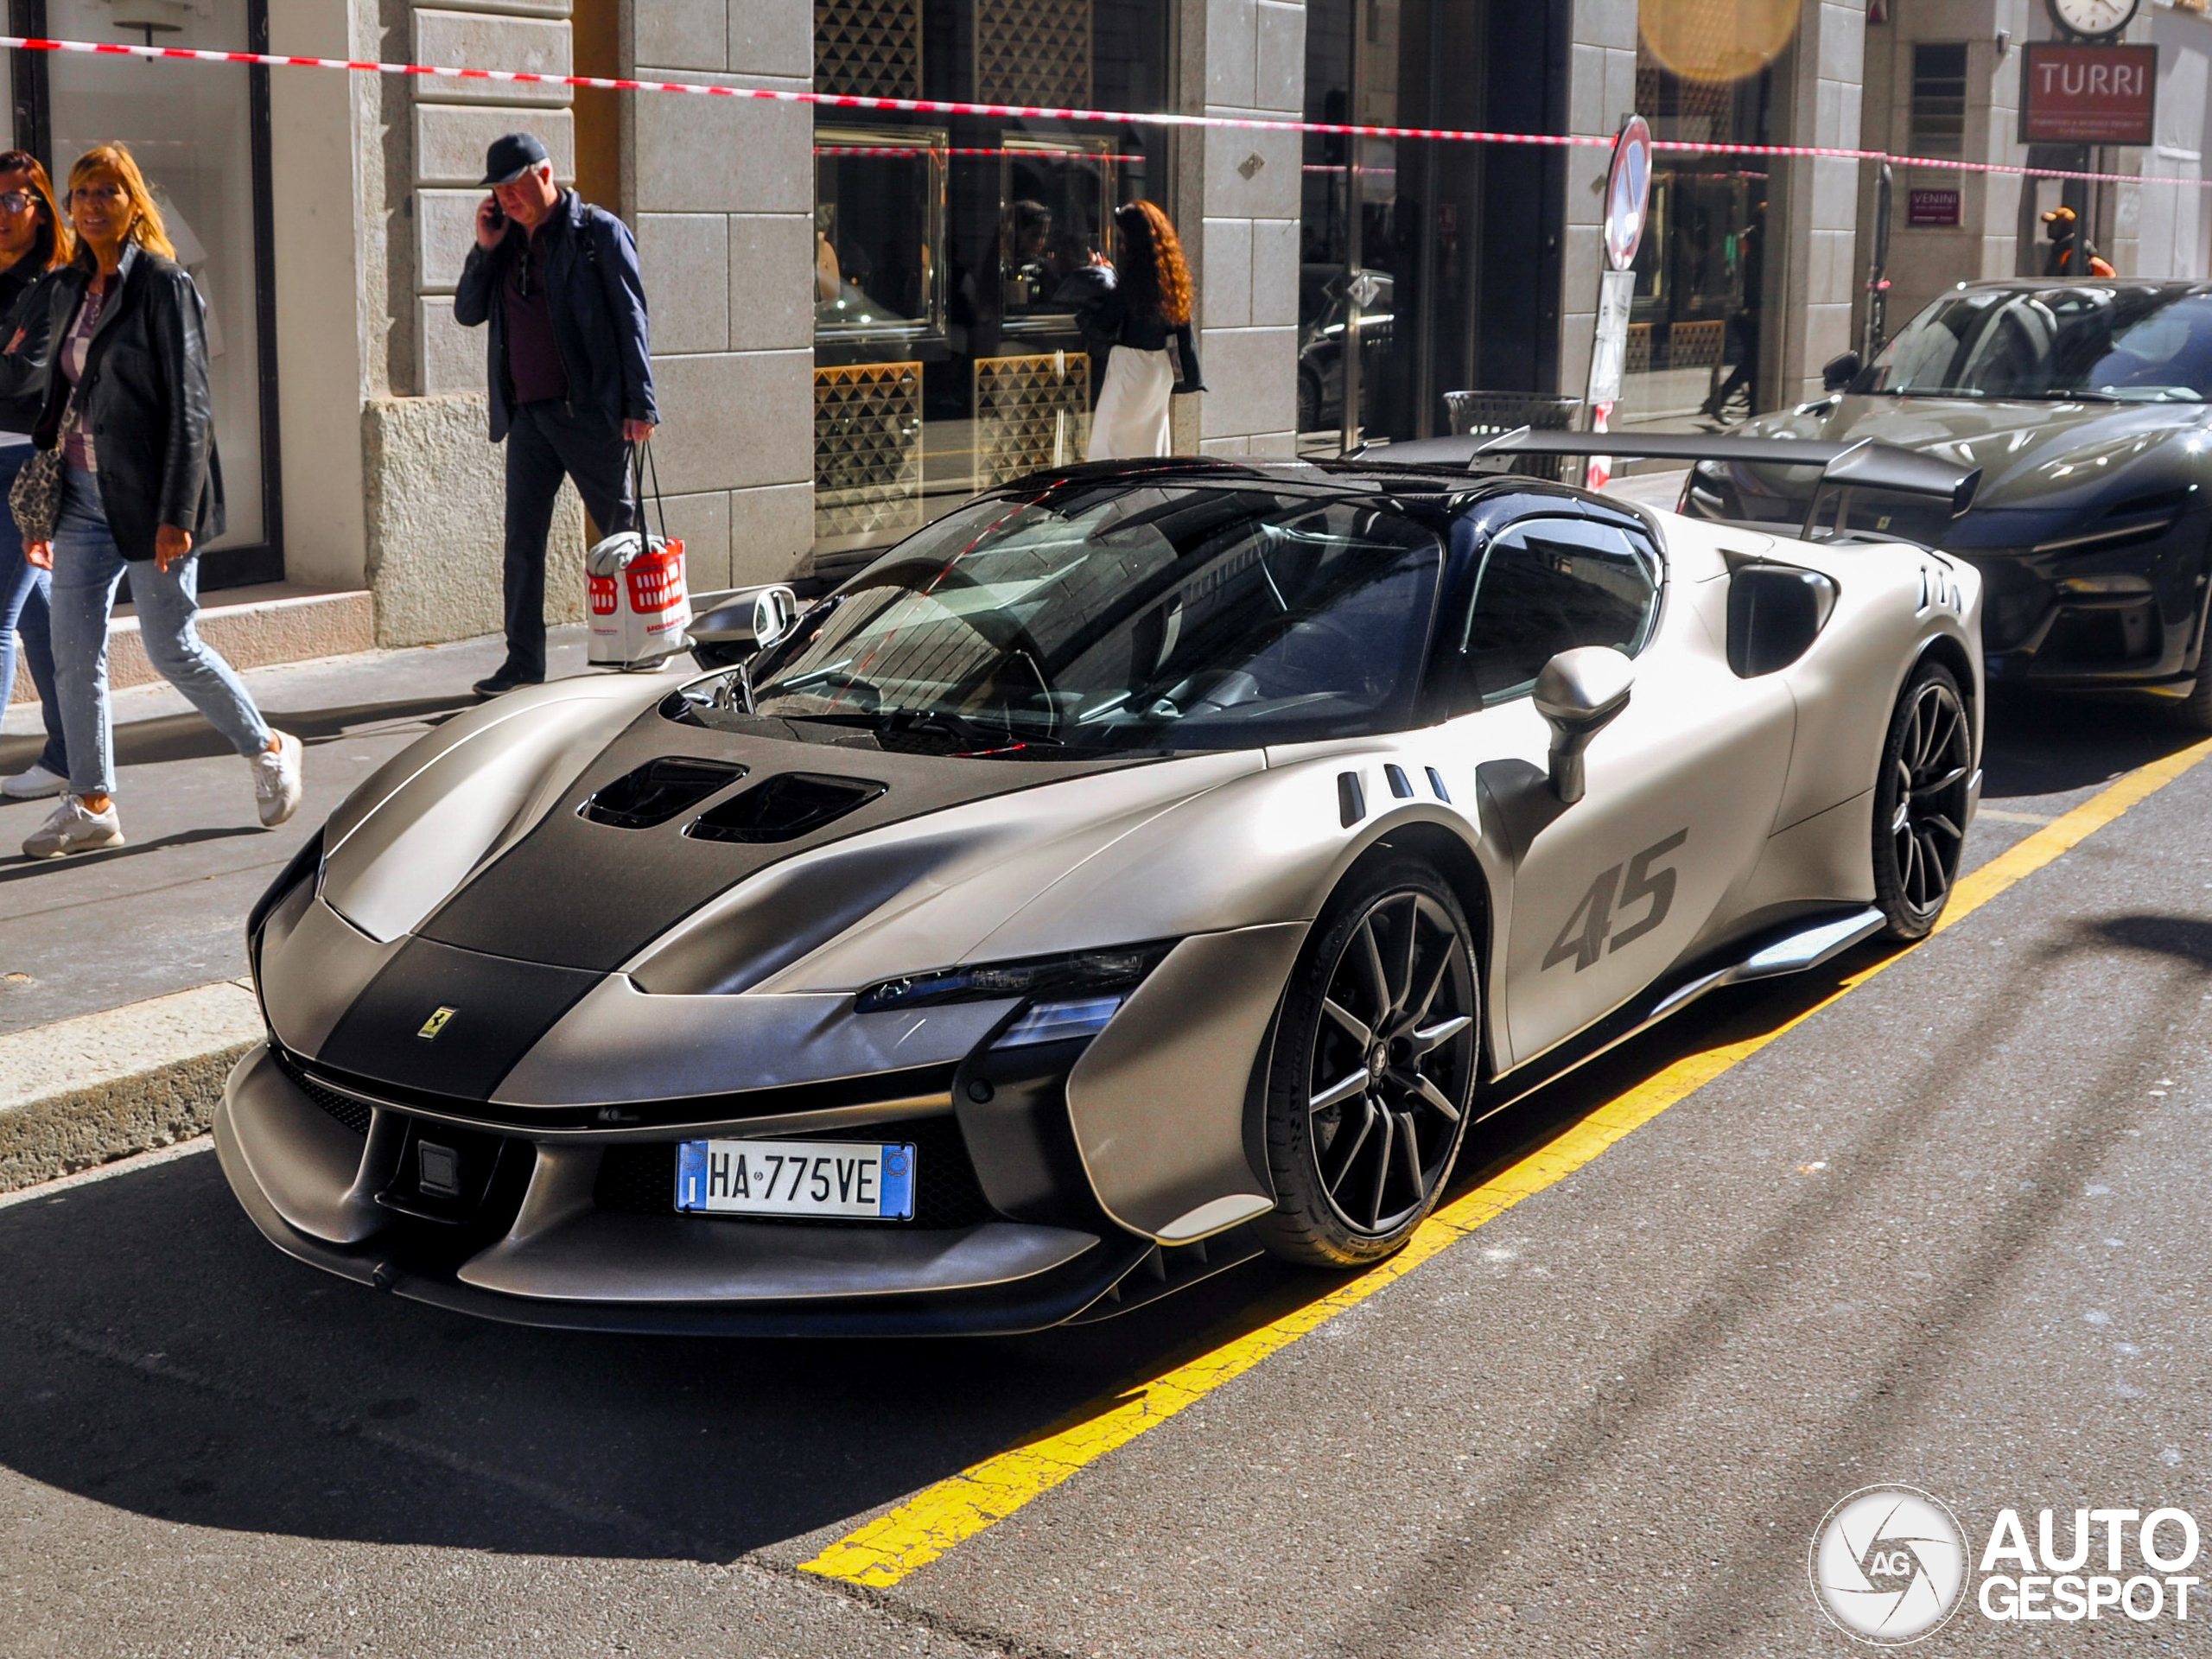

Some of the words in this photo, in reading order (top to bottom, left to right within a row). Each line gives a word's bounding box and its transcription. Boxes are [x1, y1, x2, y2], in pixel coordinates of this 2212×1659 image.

[2038, 63, 2144, 96] TURRI
[1914, 193, 1956, 204] VENINI
[1541, 826, 1689, 973] 45
